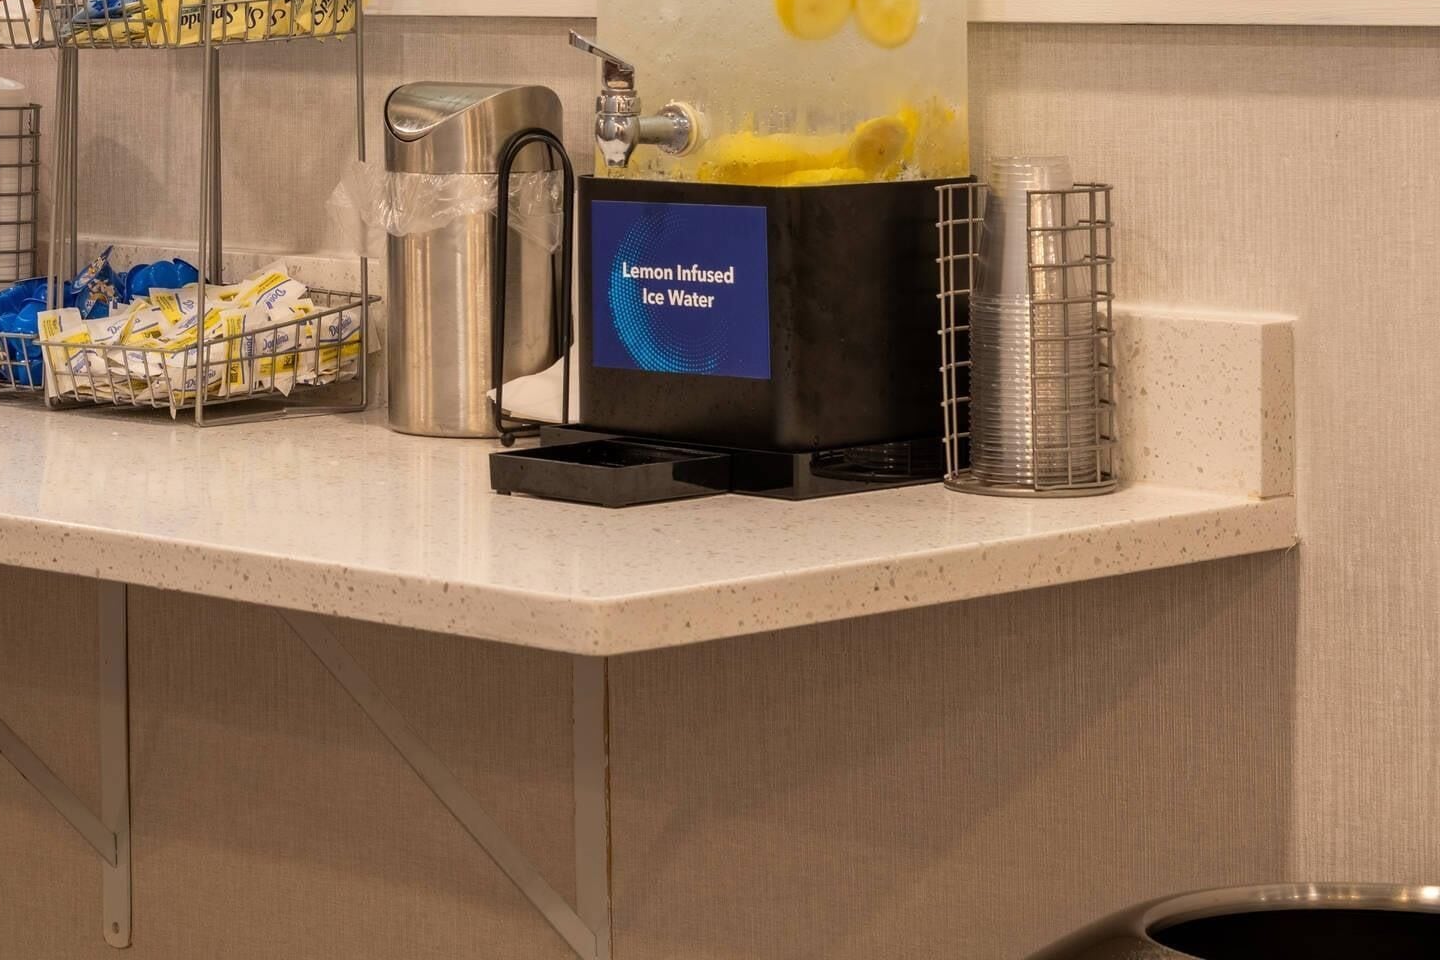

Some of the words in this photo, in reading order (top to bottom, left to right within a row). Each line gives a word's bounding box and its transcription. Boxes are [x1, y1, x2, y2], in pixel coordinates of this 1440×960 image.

[181, 3, 238, 29] Splnda
[622, 261, 673, 280] Lemon
[677, 264, 734, 284] Infused
[643, 288, 664, 305] Ice
[667, 289, 715, 308] Water
[263, 334, 289, 351] Doino
